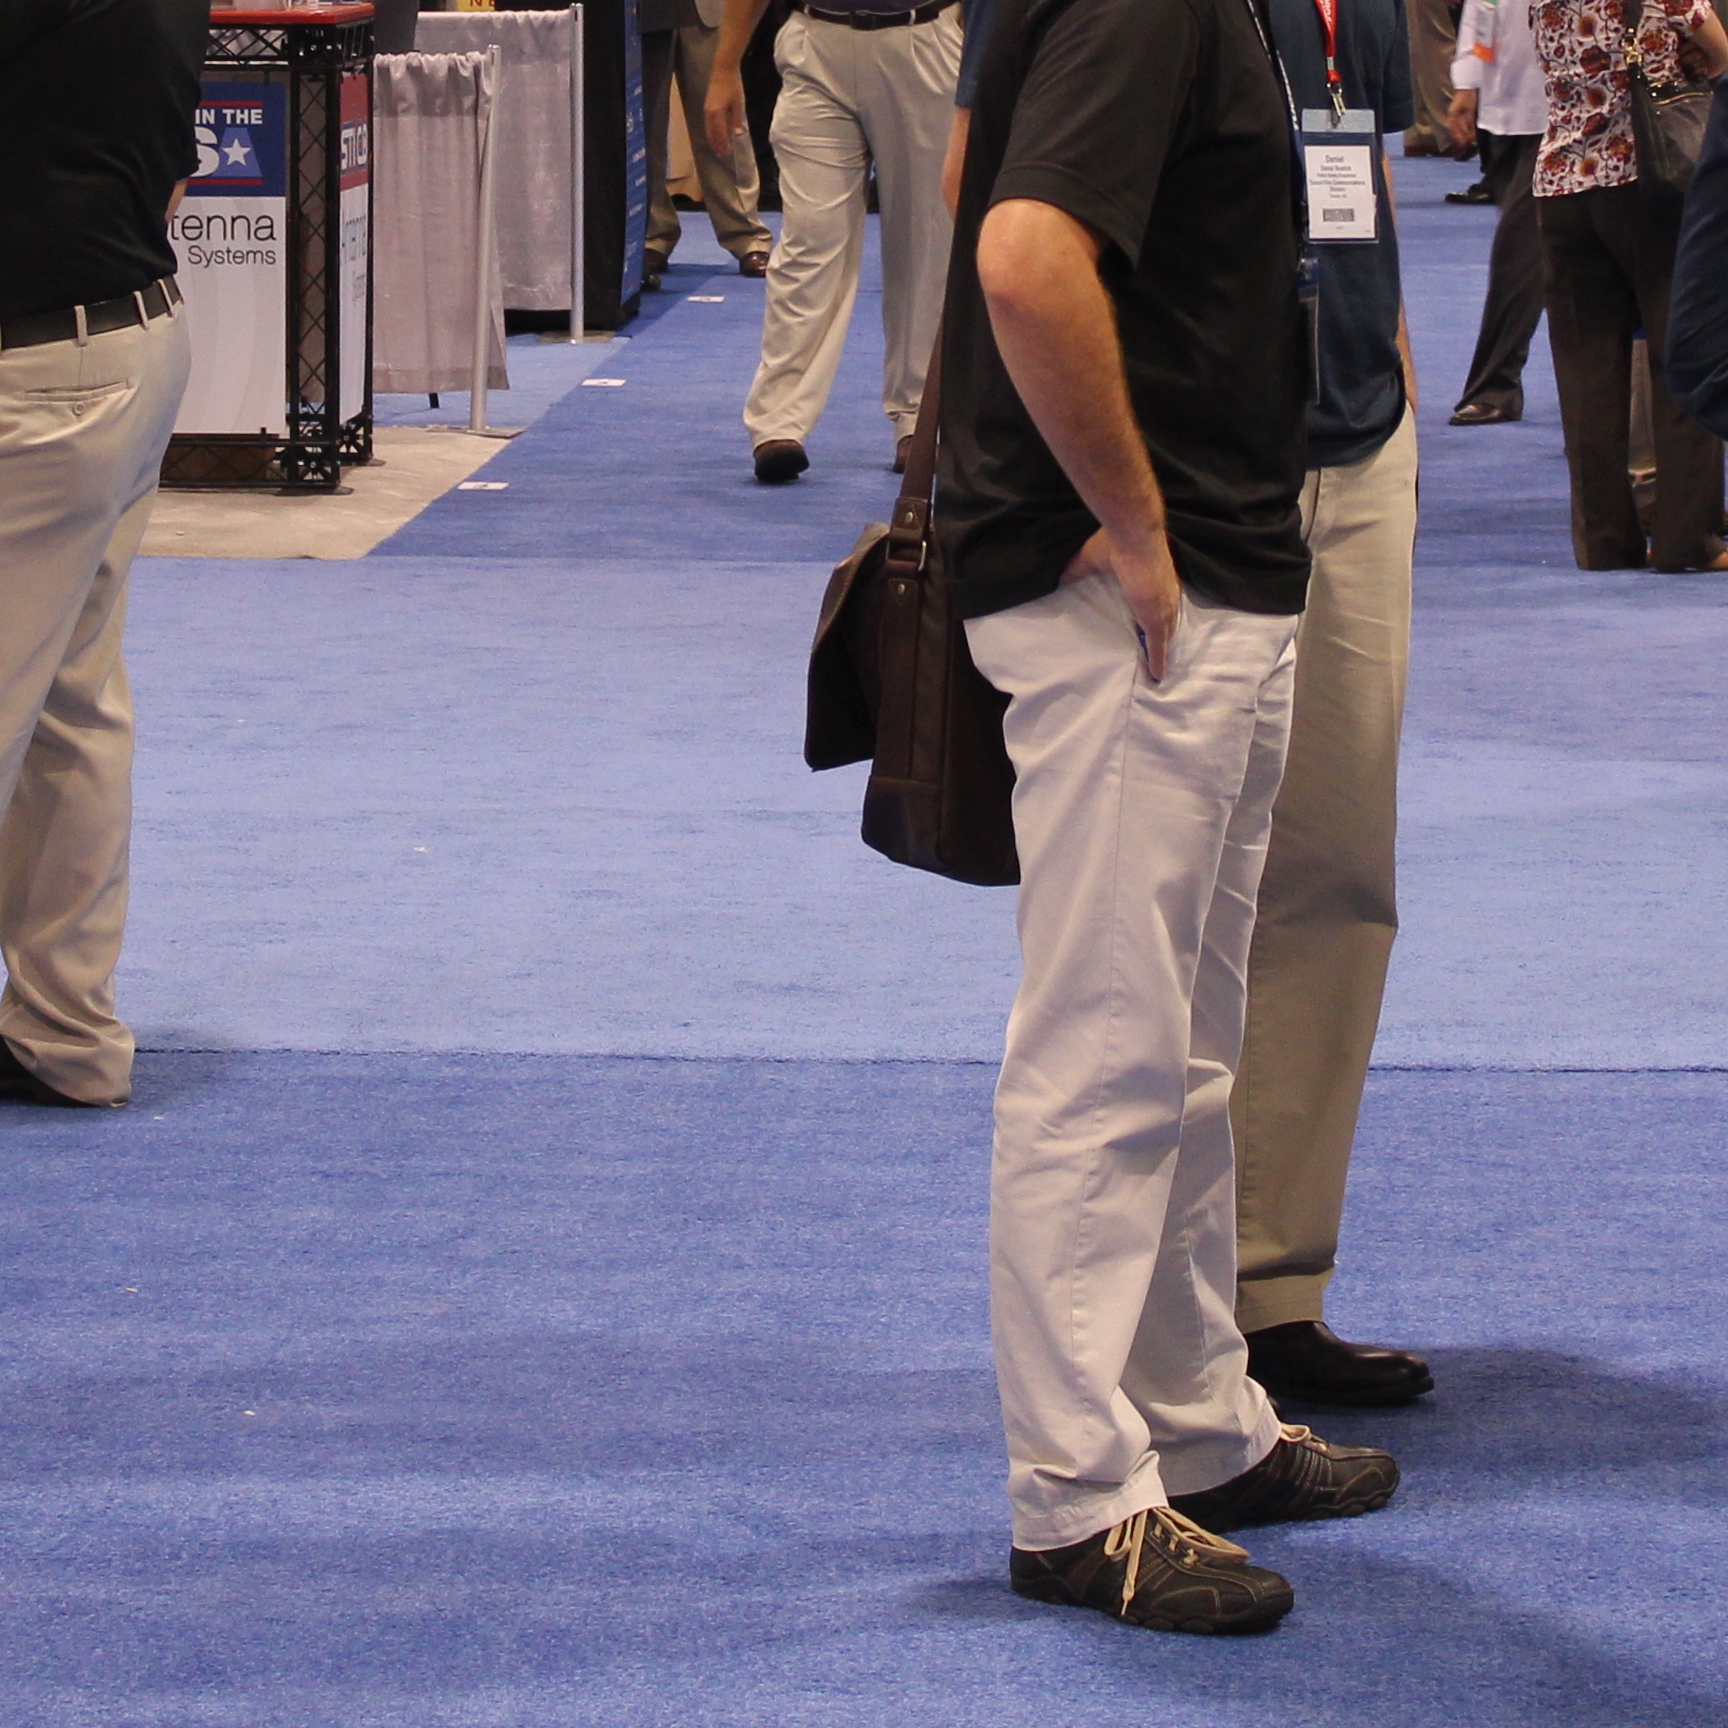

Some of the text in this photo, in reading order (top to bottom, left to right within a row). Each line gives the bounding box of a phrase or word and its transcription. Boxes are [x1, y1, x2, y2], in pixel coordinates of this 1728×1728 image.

[195, 108, 263, 125] IN THE
[187, 245, 277, 268] Systems
